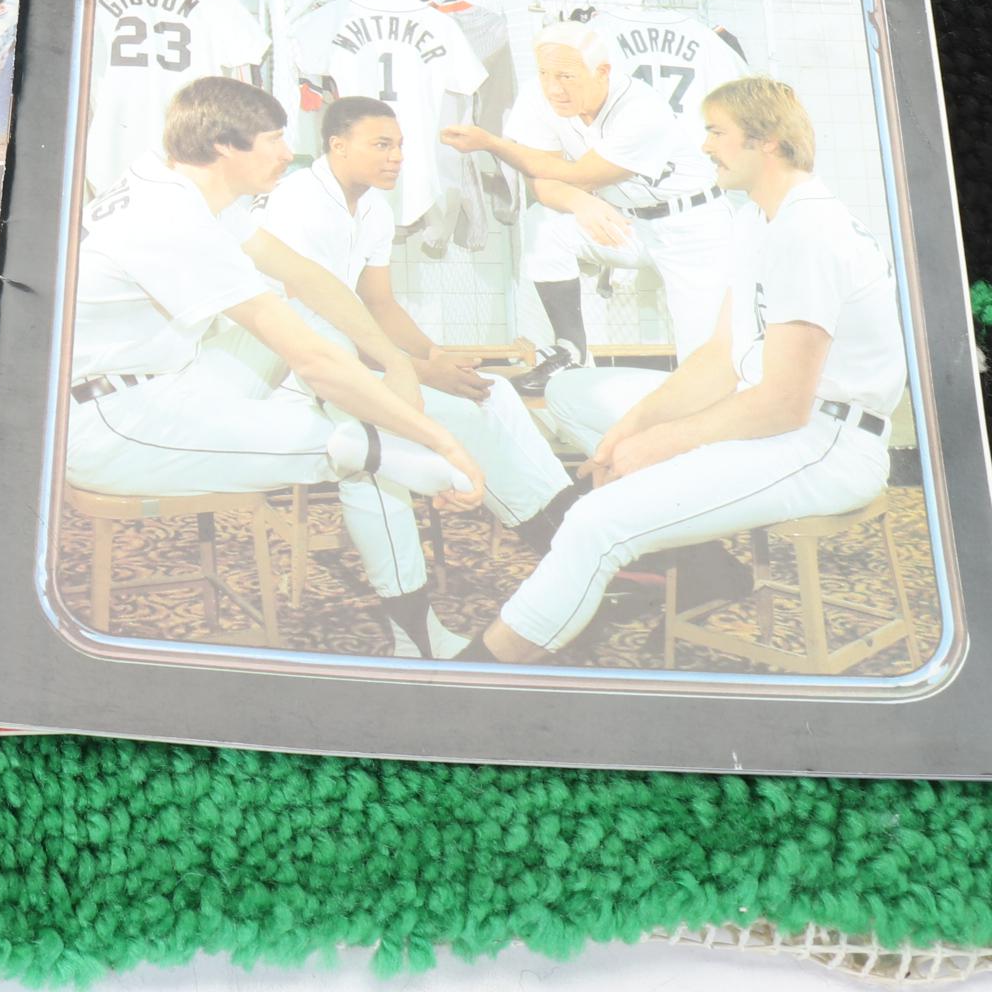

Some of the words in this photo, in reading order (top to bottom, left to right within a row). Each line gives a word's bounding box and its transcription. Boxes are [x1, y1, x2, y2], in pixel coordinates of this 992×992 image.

[110, 15, 192, 73] 23
[331, 14, 448, 65] WHITAKER
[616, 18, 700, 62] MORRIS
[377, 52, 398, 102] 1
